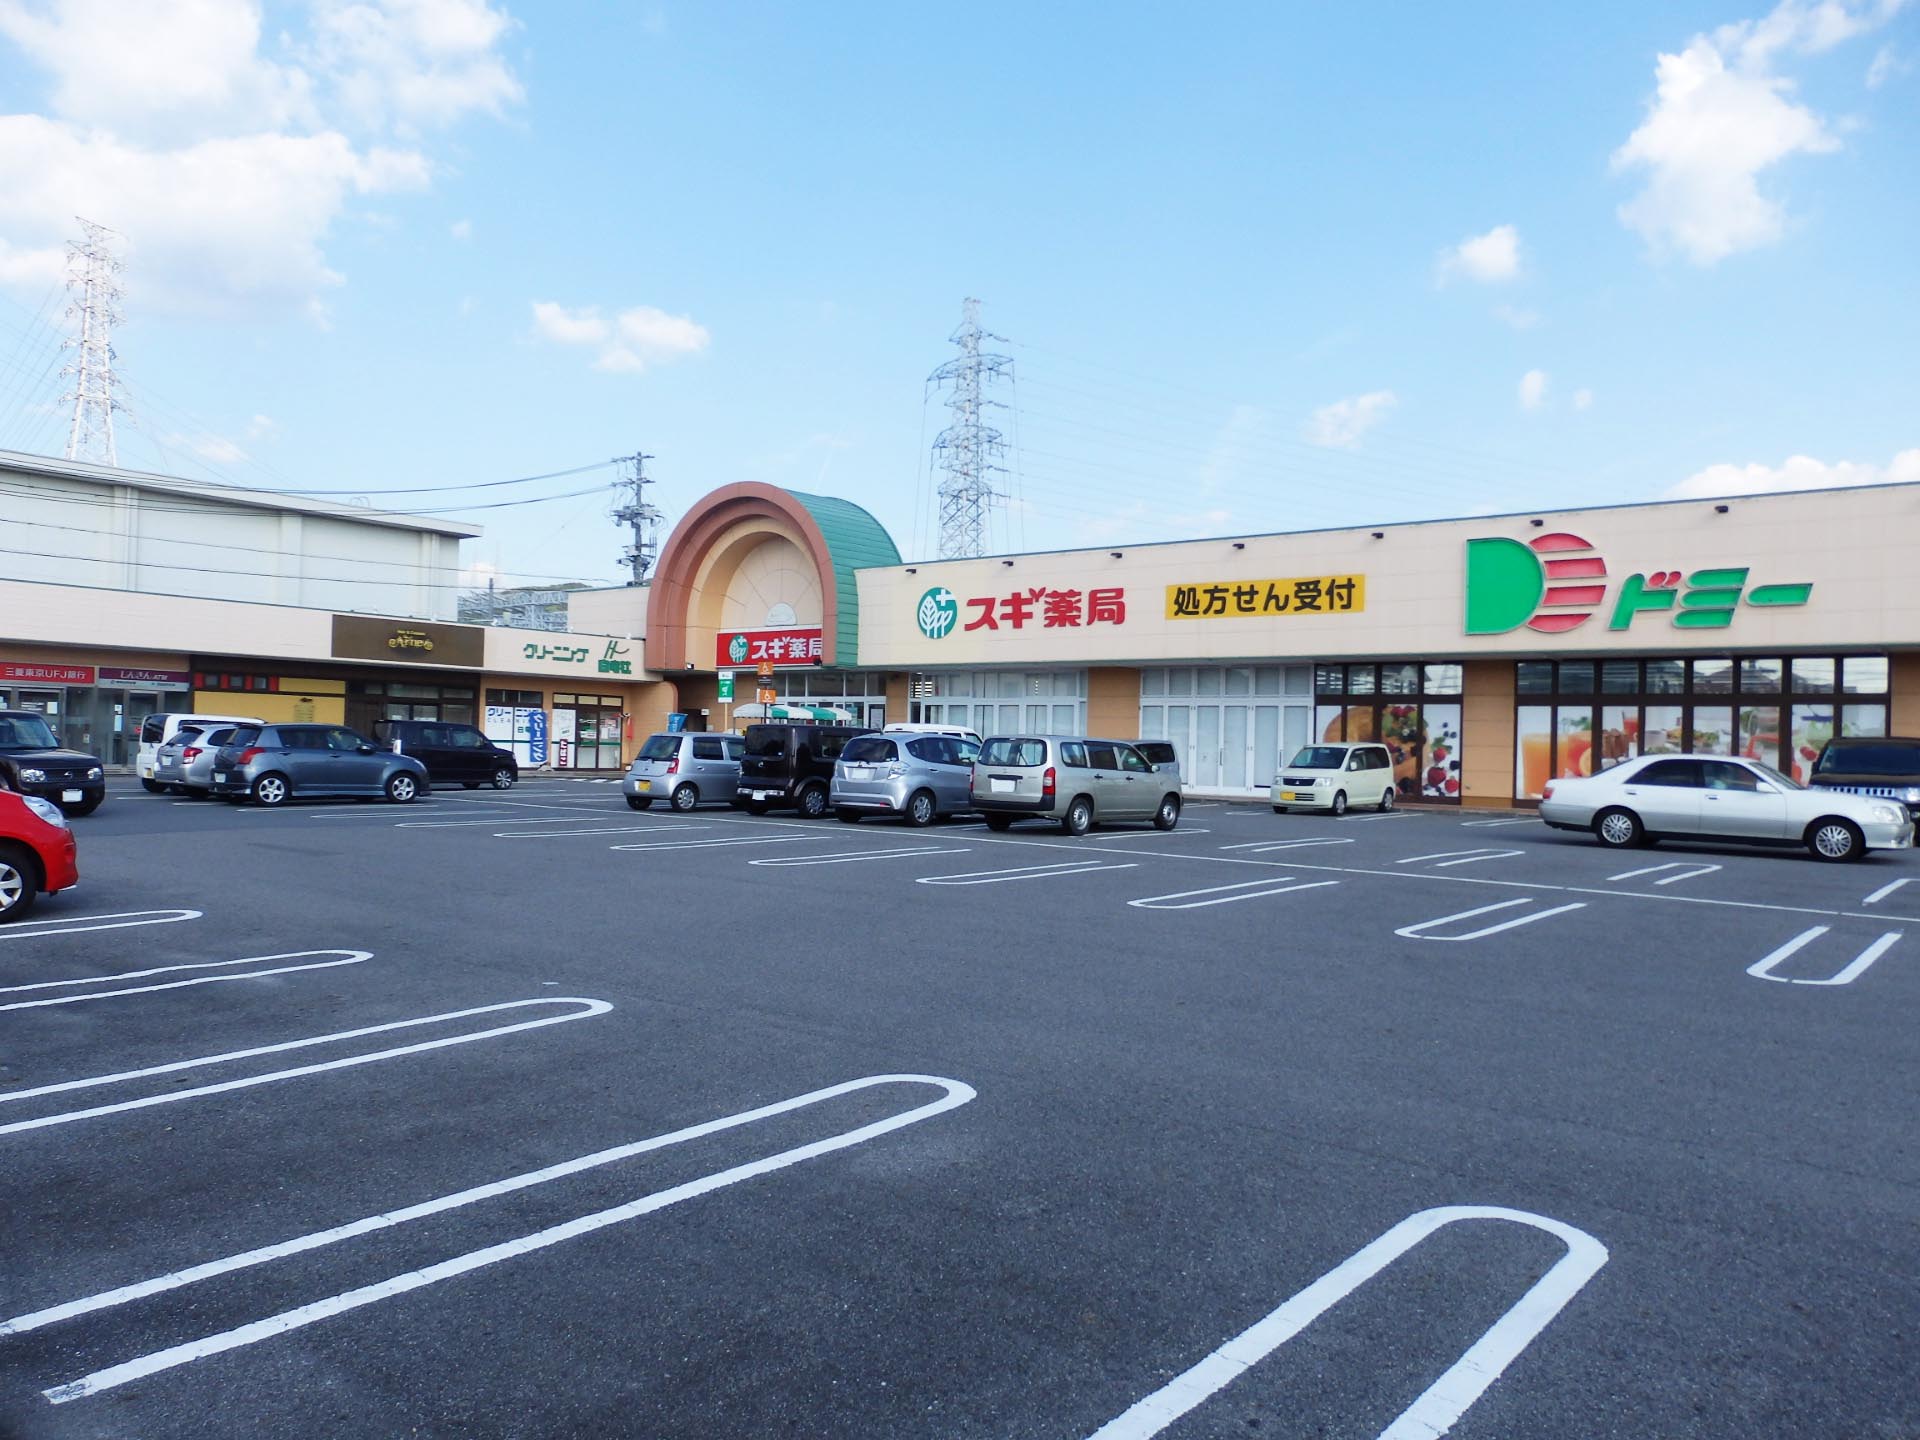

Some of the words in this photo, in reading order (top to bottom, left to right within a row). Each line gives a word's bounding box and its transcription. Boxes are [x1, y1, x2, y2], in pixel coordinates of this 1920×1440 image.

[964, 587, 1126, 632] スギ薬局
[1174, 578, 1356, 616] 処方せん受付
[1608, 567, 1814, 631] ドミー
[523, 643, 590, 662] クリーニング
[751, 636, 822, 659] スギ薬局
[5, 666, 87, 680] 三菱東京UFJ銀行
